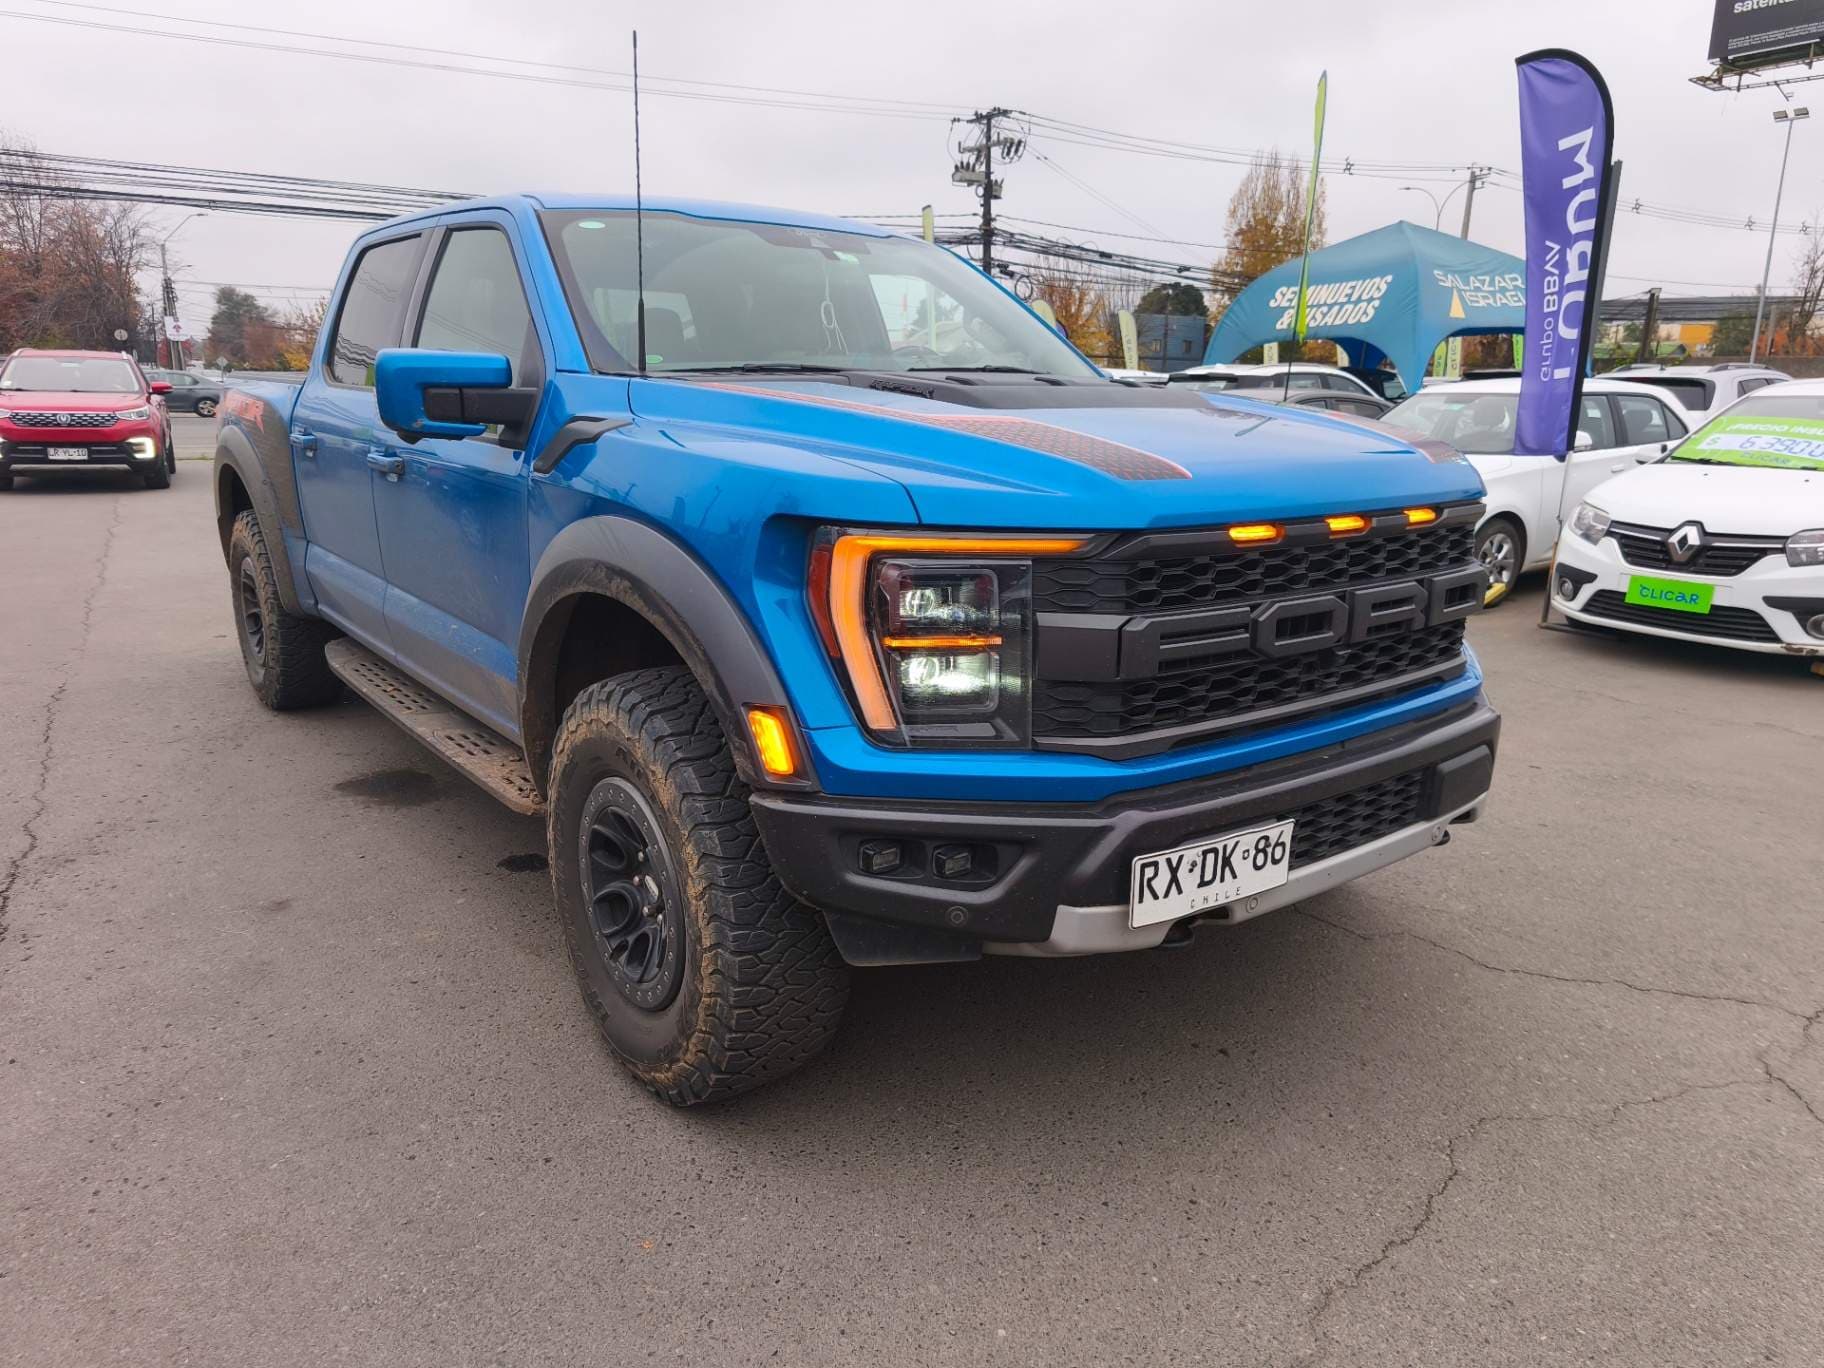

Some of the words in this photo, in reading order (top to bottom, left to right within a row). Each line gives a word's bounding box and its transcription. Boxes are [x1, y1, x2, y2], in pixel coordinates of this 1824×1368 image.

[1433, 269, 1526, 290] SALAZAR
[1120, 568, 1487, 680] FORD
[1190, 886, 1242, 910] CHILE
